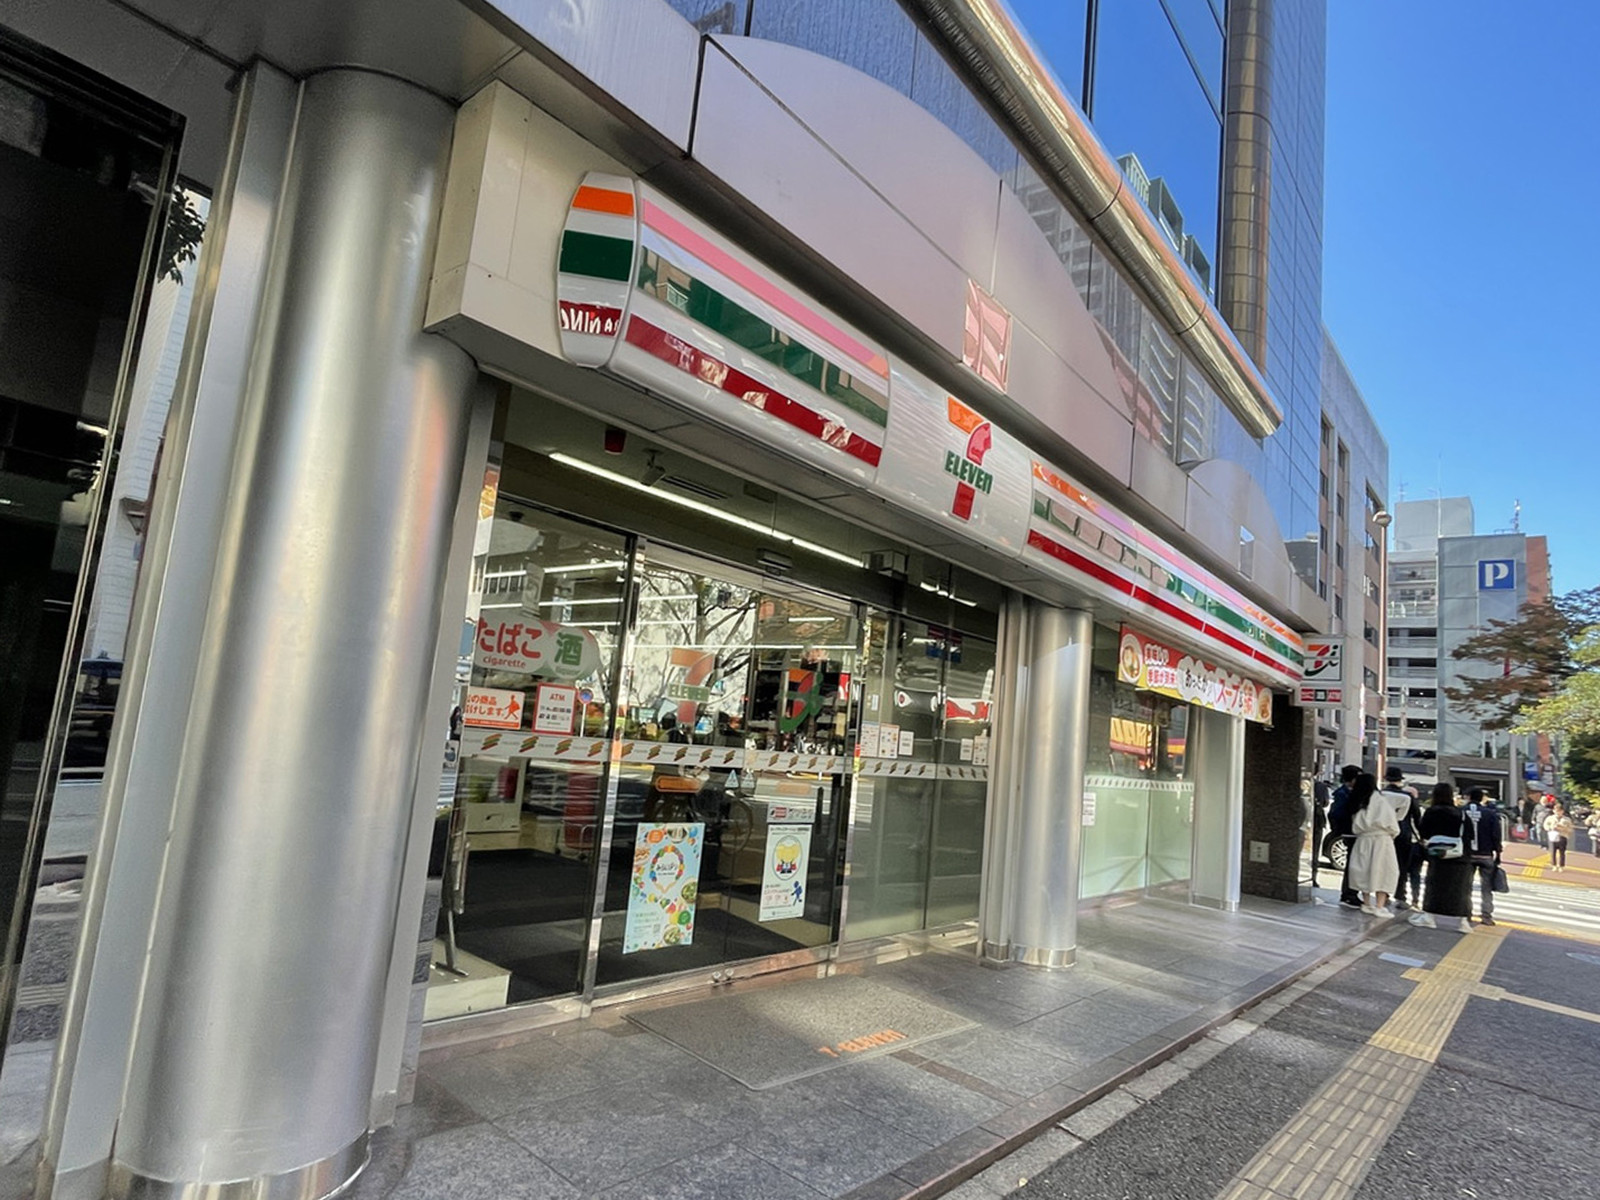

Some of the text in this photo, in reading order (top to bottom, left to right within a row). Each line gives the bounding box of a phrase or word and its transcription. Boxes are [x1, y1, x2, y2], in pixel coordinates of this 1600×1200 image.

[1484, 563, 1509, 587] P
[554, 631, 585, 666] 酒
[482, 654, 527, 668] cigarette
[466, 694, 497, 706] の商品
[549, 693, 565, 702] ATM
